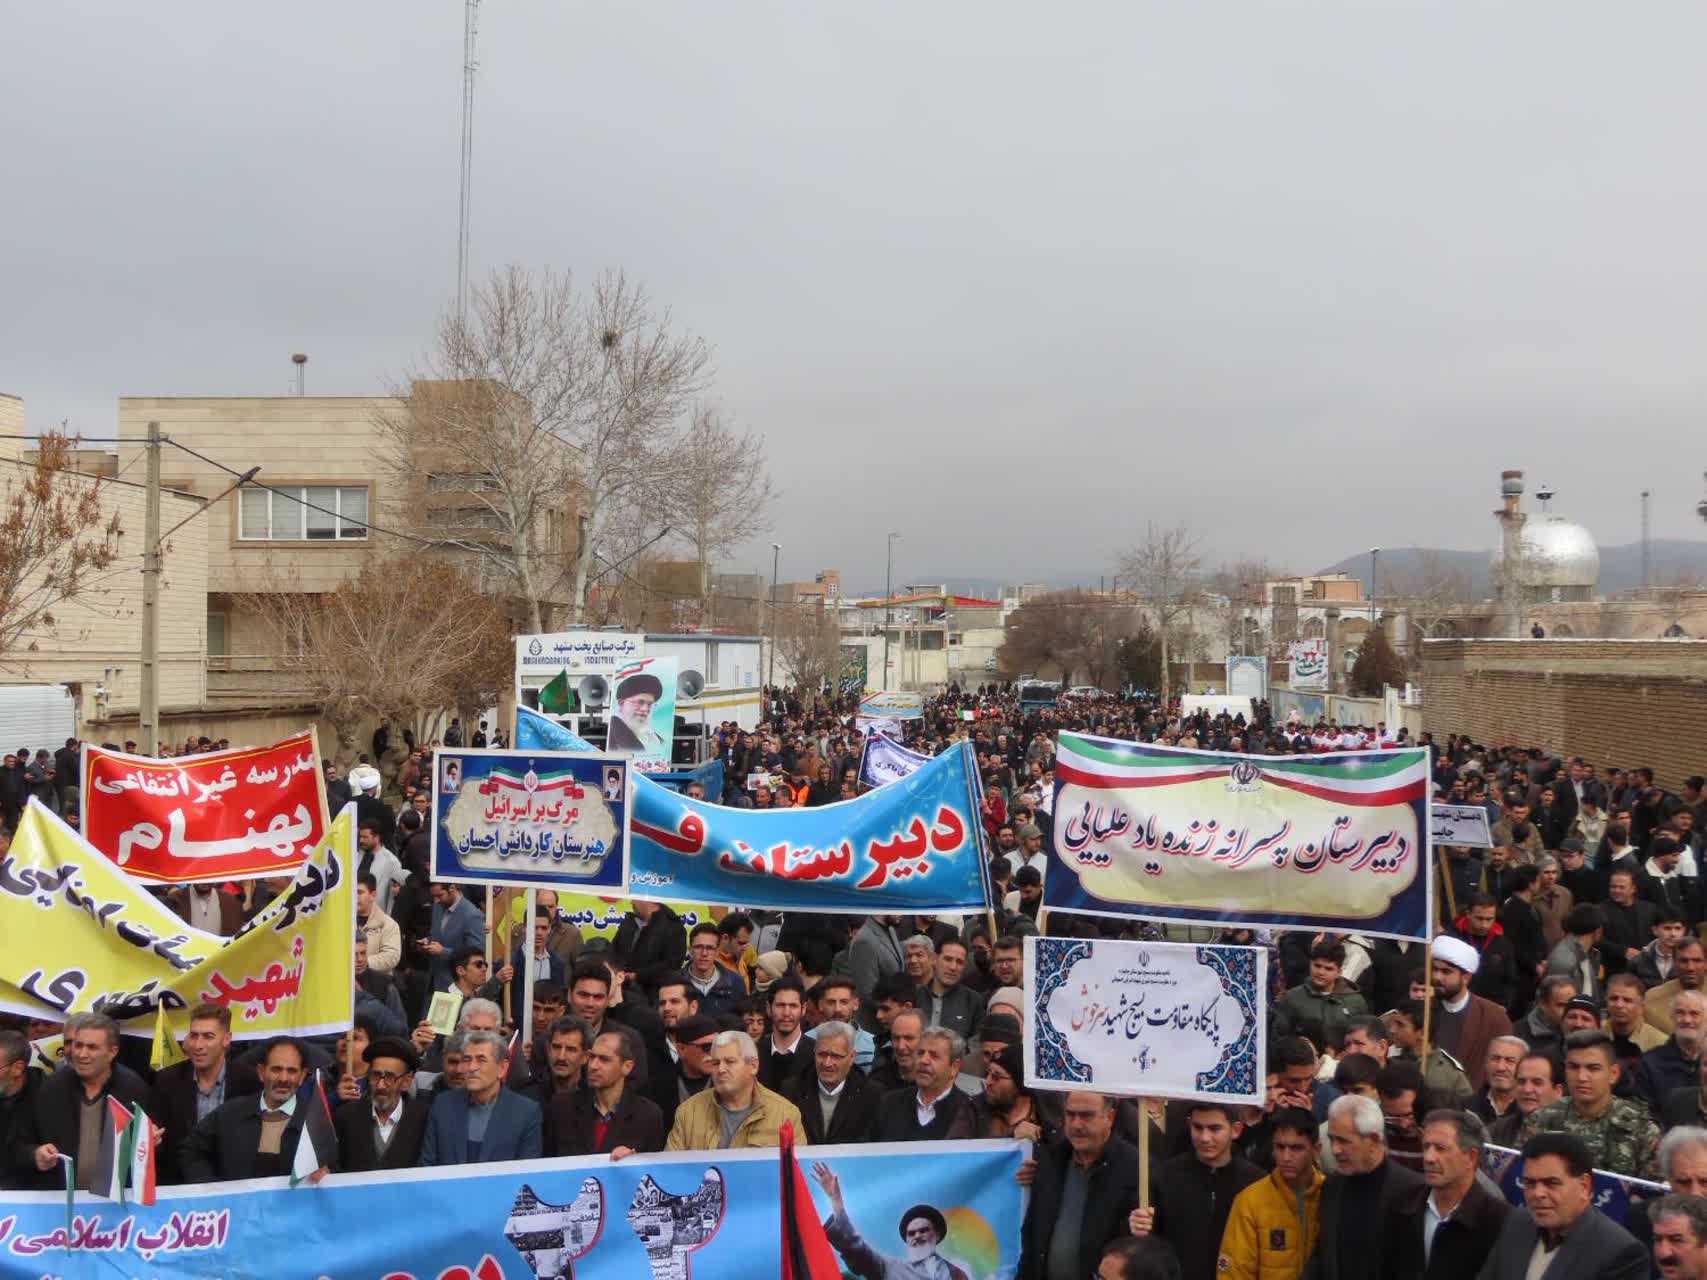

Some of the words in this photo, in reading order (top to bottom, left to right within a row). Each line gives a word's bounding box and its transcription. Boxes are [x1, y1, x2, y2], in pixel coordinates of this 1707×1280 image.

[94, 770, 189, 795] انتفاعی
[193, 765, 237, 803] غیر
[485, 795, 532, 822] اسرائیل
[532, 804, 545, 823] بر
[546, 799, 579, 824] مرگ
[118, 804, 313, 866] بهنام
[458, 828, 499, 853] احسان
[552, 831, 606, 861] هنرستان
[719, 807, 963, 888] دبیرستان
[1132, 816, 1161, 875] یاد
[1162, 819, 1216, 855] زنده
[1213, 818, 1290, 868] پسرانه
[1293, 816, 1409, 872] دبیرستان
[201, 937, 305, 1018] شهید
[1102, 993, 1129, 1036] شهید
[1125, 992, 1146, 1040] بسیج
[1146, 1004, 1192, 1030] مقاومت
[1193, 994, 1221, 1047] پایگاه
[11, 1214, 134, 1256] اسلامی
[137, 1209, 230, 1261] انقلاب
